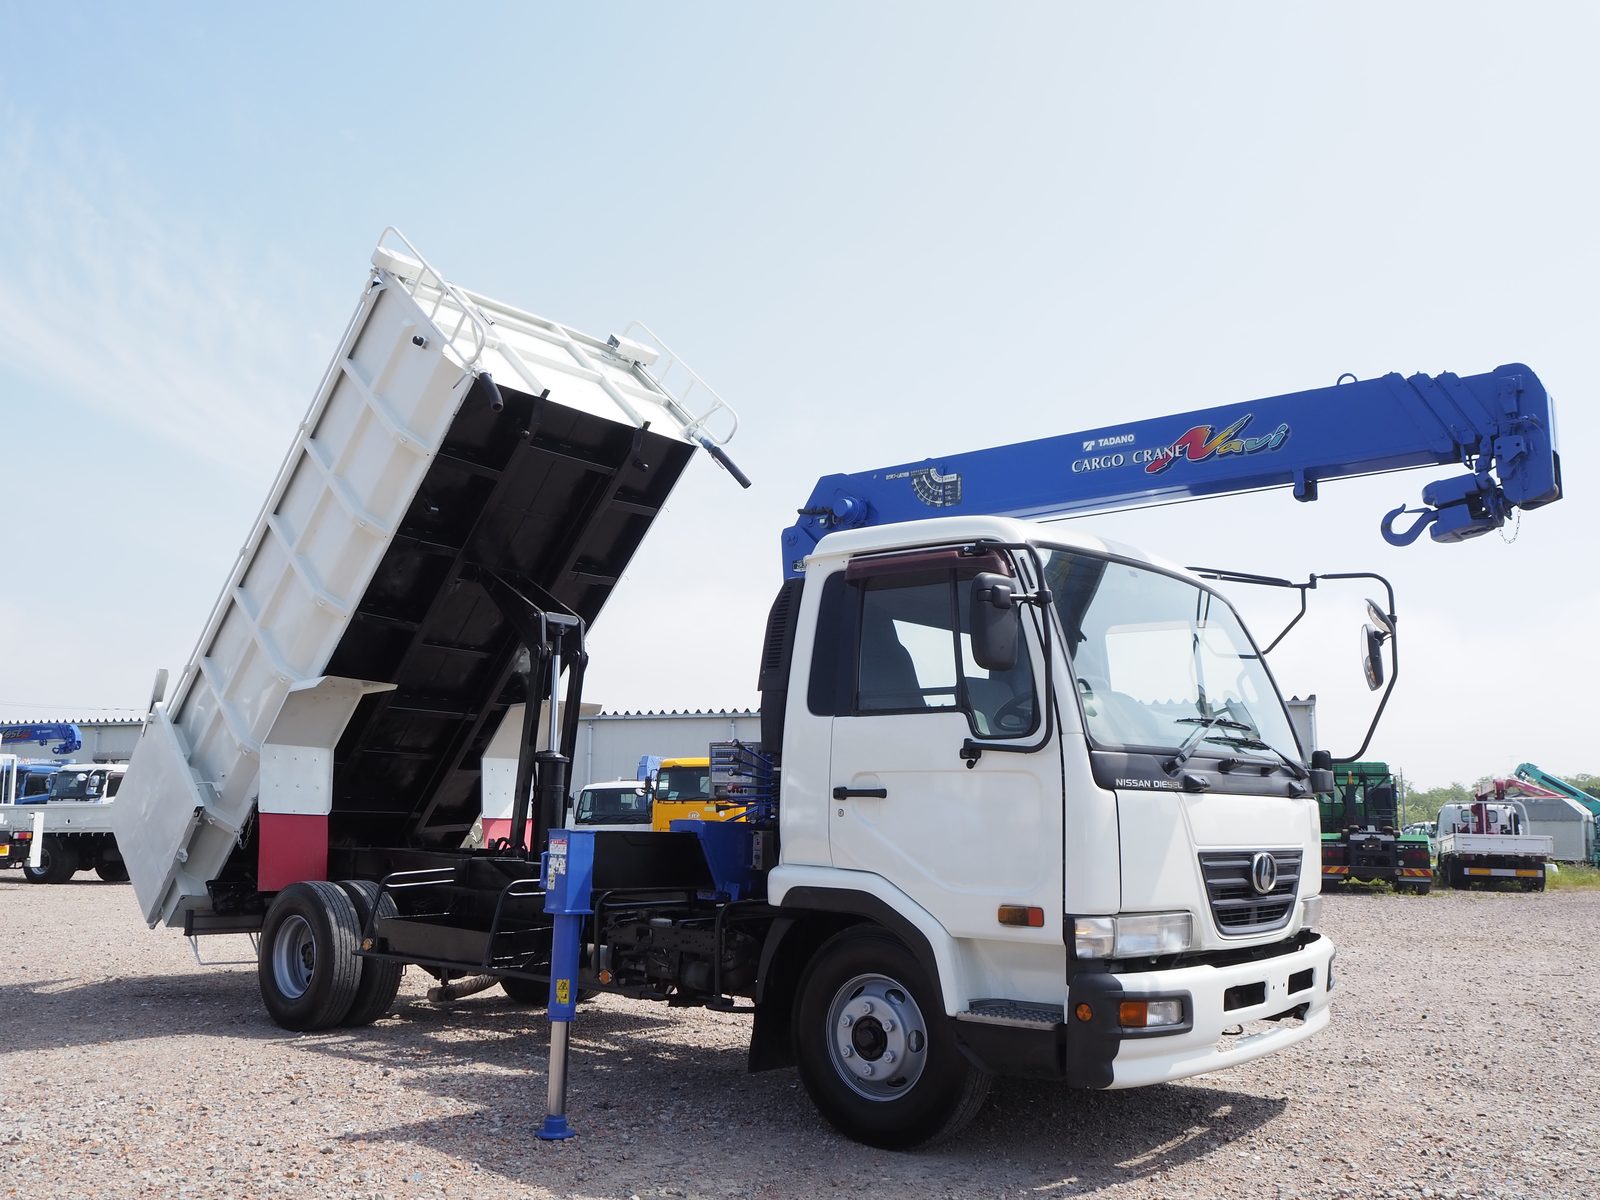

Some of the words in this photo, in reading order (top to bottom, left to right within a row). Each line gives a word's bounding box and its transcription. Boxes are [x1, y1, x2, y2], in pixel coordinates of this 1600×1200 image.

[1098, 434, 1135, 448] TADANO
[1071, 453, 1125, 473] CARGO
[1132, 444, 1184, 464] CRANE
[1115, 778, 1151, 788] NISSAN
